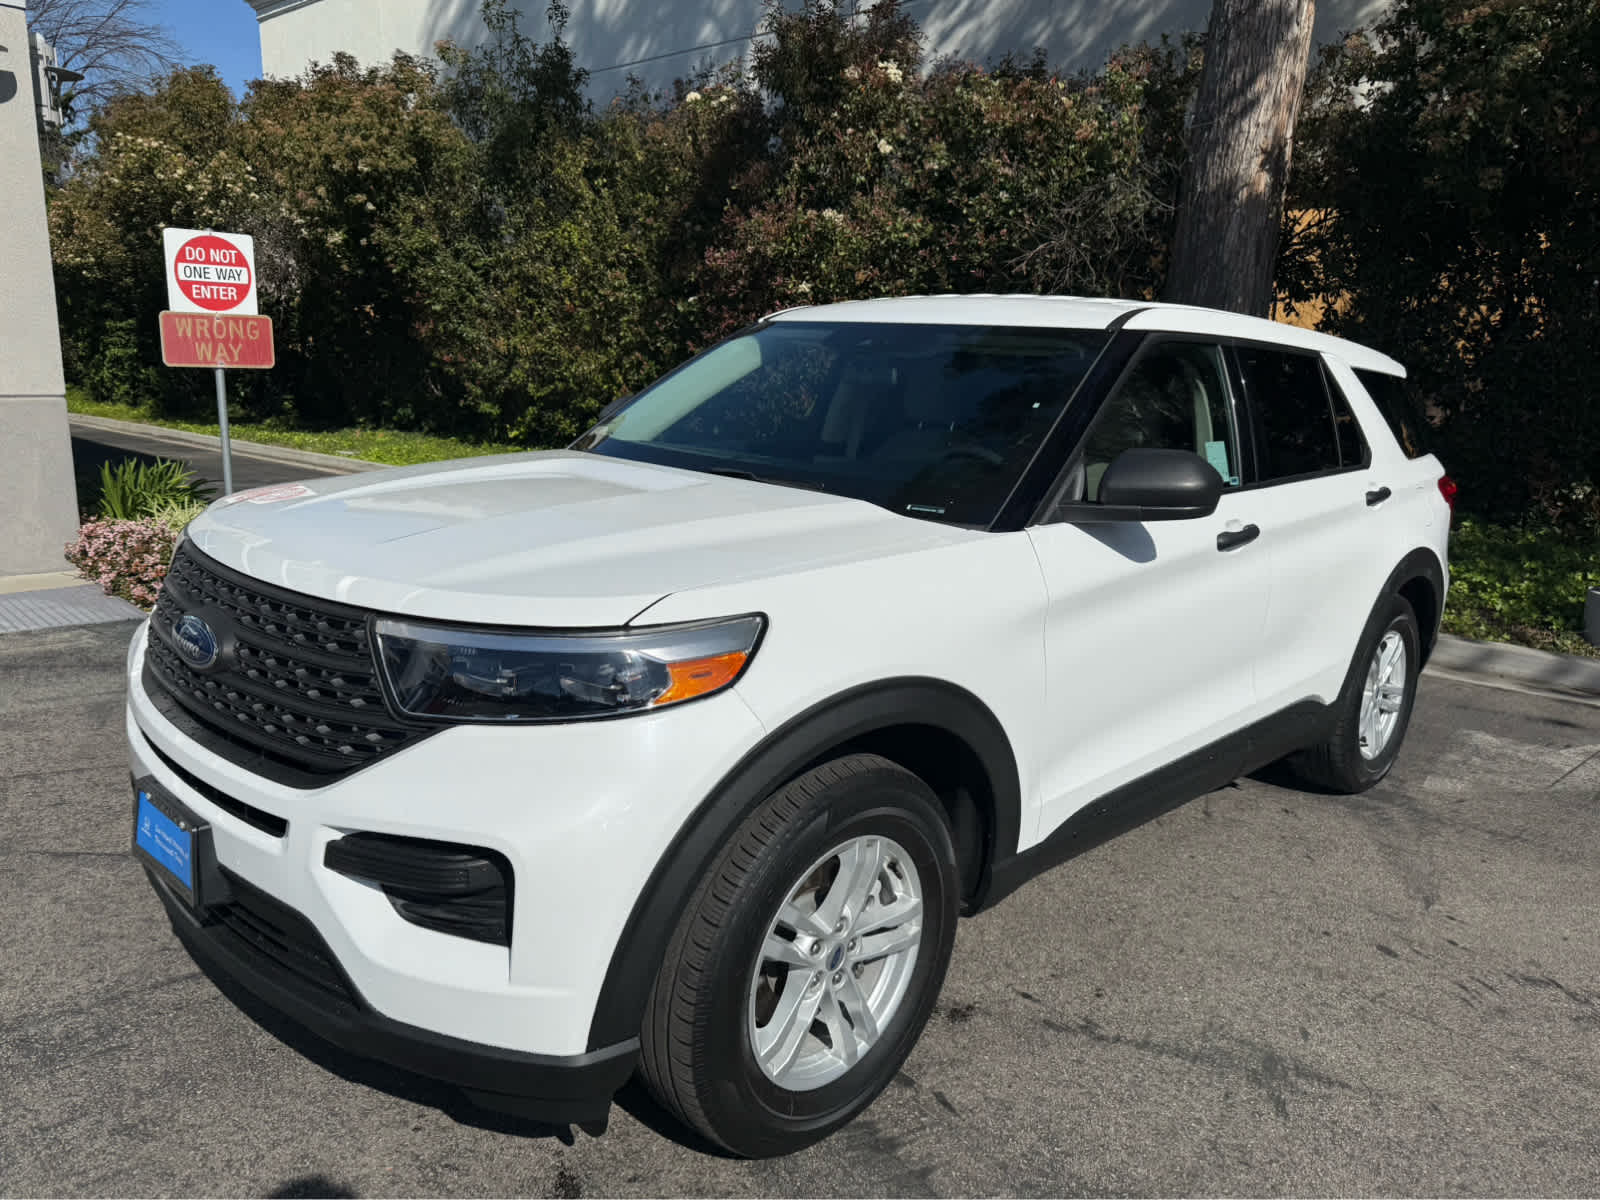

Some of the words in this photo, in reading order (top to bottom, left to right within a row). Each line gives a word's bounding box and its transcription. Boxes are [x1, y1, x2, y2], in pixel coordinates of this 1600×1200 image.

[185, 247, 206, 262] DO
[210, 248, 238, 264] NOT
[183, 265, 211, 280] ONE
[215, 267, 243, 282] WAY
[192, 284, 238, 301] ENTER
[175, 317, 260, 340] WRONG
[195, 342, 243, 362] WAY
